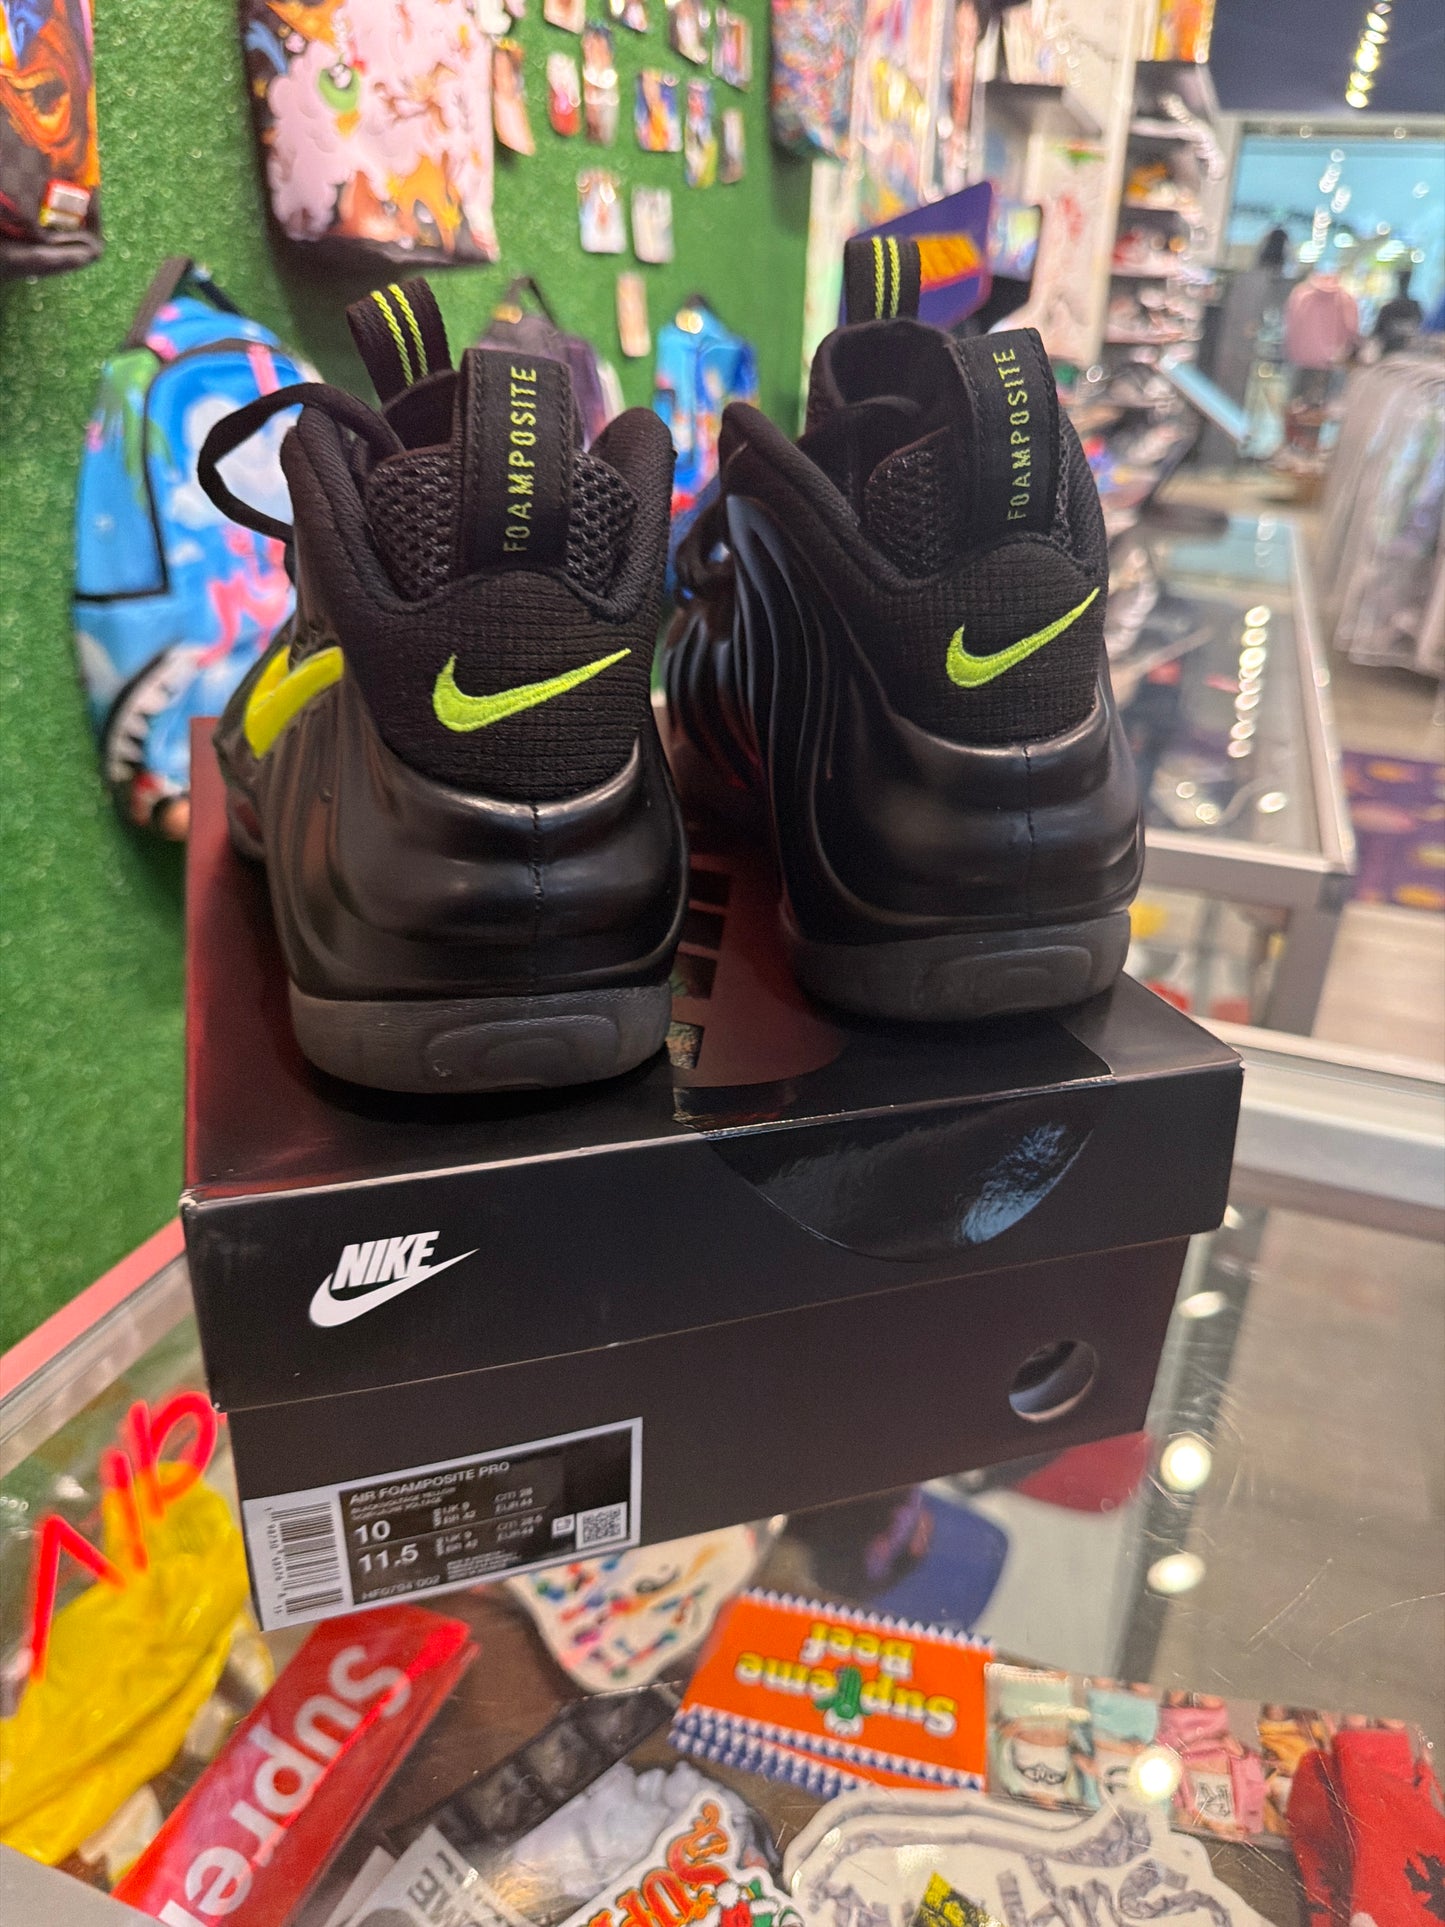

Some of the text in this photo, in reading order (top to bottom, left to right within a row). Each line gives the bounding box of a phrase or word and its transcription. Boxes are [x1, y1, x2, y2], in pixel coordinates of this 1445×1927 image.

[503, 366, 537, 552] FOAMPOSITE
[993, 349, 1031, 521] FOAMPOSITE
[331, 1231, 440, 1291] NIKE
[350, 1461, 510, 1505] AIR FOAMPOSITE PRO
[353, 1520, 391, 1545] 10
[358, 1543, 419, 1575] 11.5
[801, 1619, 916, 1680] Beef
[735, 1650, 957, 1737] Supeme
